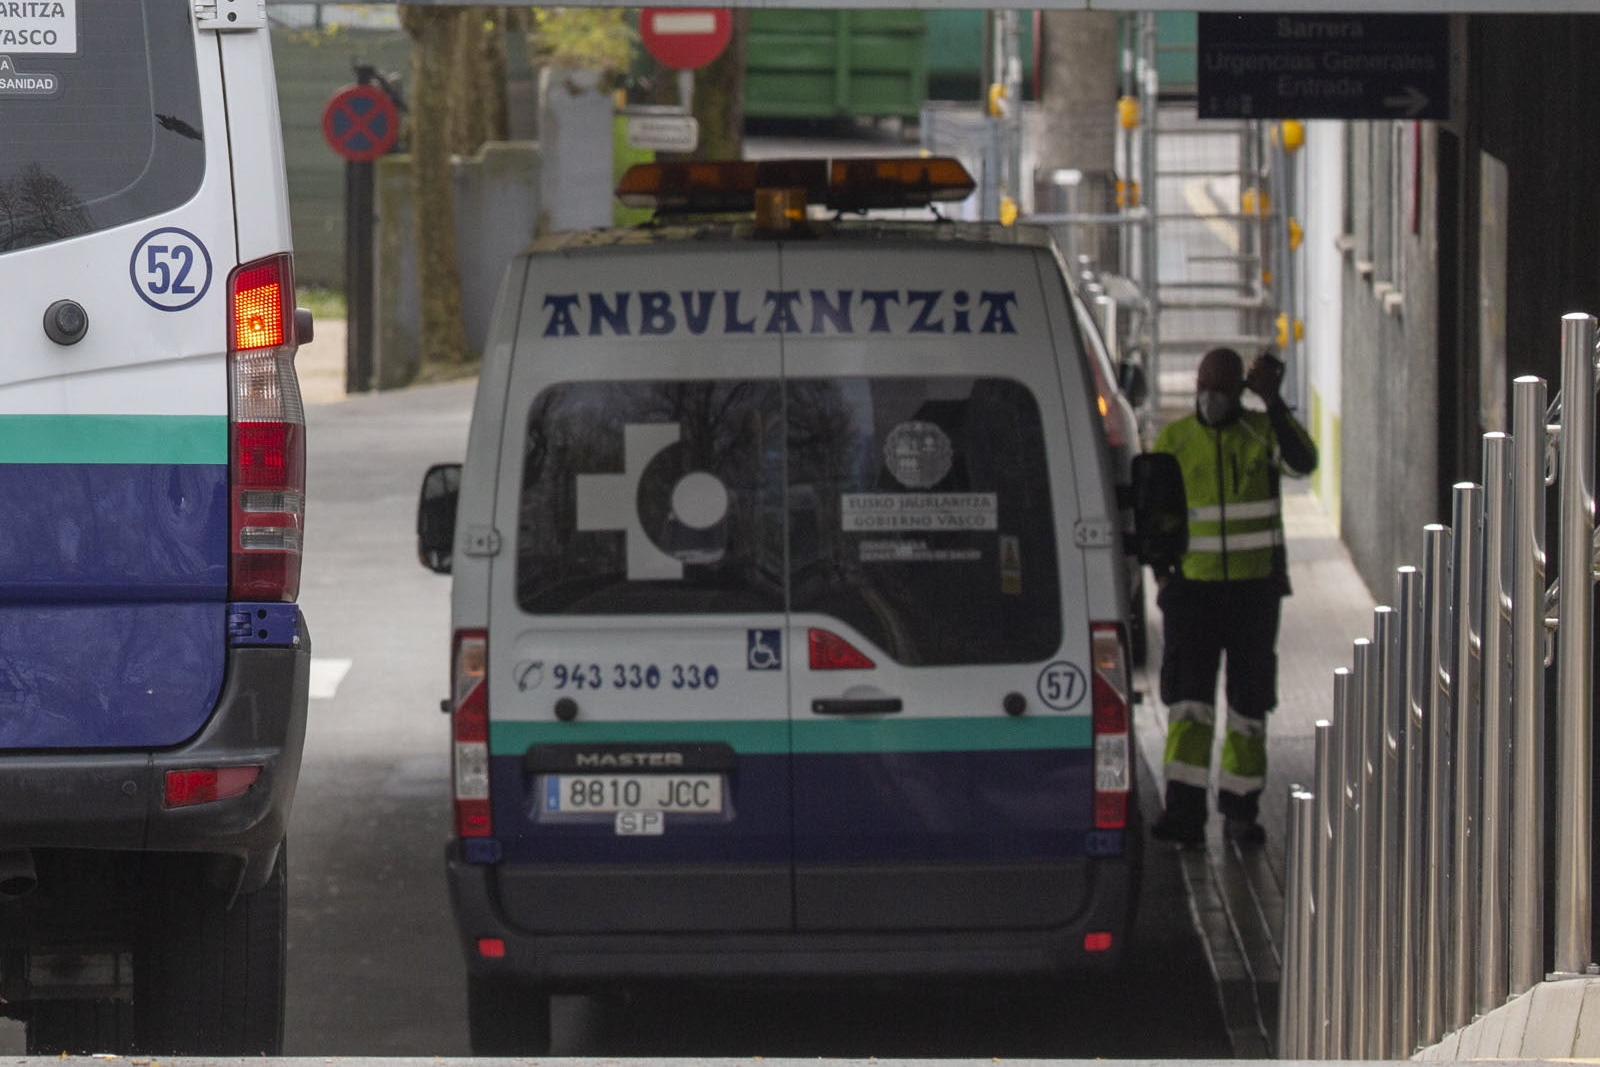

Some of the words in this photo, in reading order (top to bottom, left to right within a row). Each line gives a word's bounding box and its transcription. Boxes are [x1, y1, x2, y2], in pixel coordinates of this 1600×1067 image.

[1322, 51, 1436, 72] Generales
[1278, 75, 1364, 96] Entrada
[147, 245, 196, 295] 52
[553, 663, 603, 690] 943
[613, 663, 660, 690] 330
[672, 663, 719, 690] 330
[1047, 671, 1075, 700] 57
[576, 752, 684, 766] MASTER
[569, 780, 641, 807] 8810
[658, 780, 710, 807] JCC
[619, 813, 659, 833] SP
